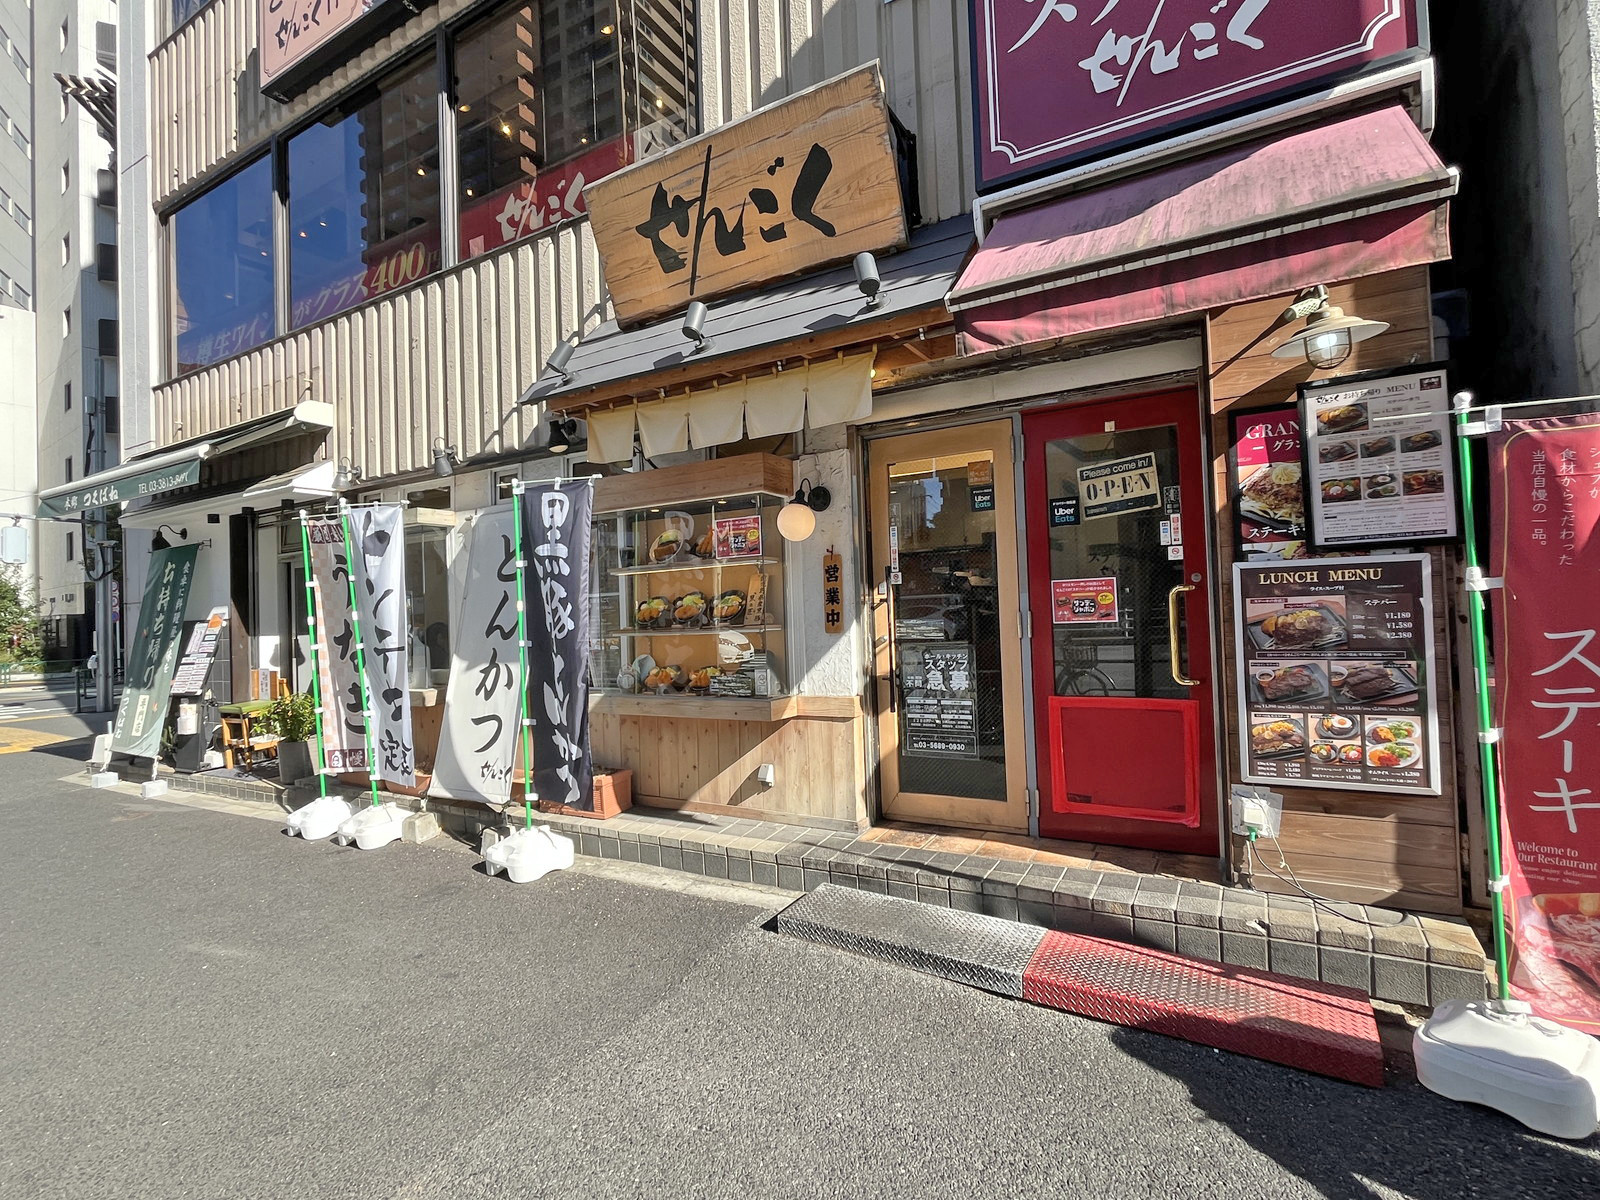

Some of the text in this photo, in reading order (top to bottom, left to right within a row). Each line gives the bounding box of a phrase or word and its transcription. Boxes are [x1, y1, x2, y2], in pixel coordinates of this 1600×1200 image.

[635, 142, 836, 296] せんごく
[1387, 383, 1416, 393] MENU
[1083, 468, 1111, 479] Please
[1112, 462, 1136, 473] come
[1531, 450, 1548, 546] 当店自慢の一品。
[1559, 448, 1577, 567] 食材からこだわった
[1054, 507, 1075, 516] Uber
[1055, 515, 1075, 523] Eats
[1259, 568, 1383, 586] LUNCH MENU
[825, 565, 841, 627] 営業中
[471, 534, 523, 753] とんかつ
[925, 659, 968, 670] スタッフ
[926, 670, 969, 692] 急募
[1528, 629, 1600, 834] ステーキ
[1517, 841, 1579, 857] Welcome to
[1517, 852, 1598, 871] Our Restaurant
